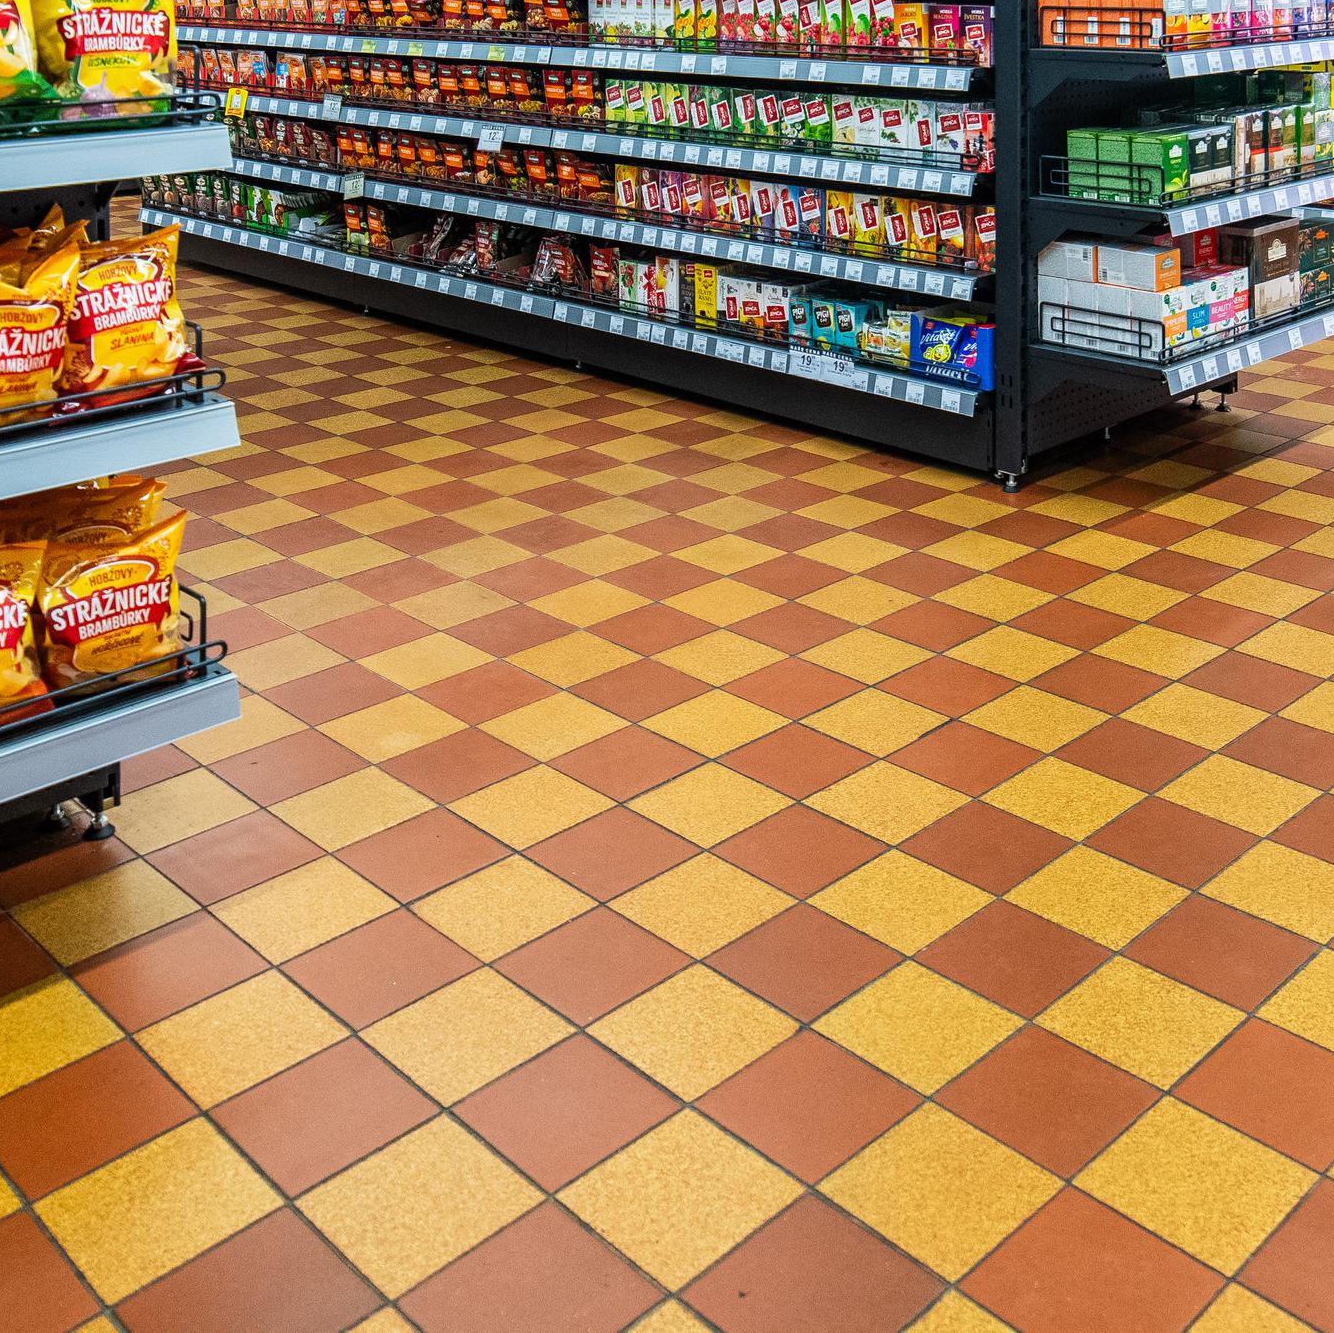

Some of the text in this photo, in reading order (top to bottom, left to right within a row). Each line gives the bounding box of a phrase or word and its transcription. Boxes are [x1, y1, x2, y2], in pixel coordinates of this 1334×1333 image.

[63, 8, 165, 39] STRÁŽNICKÉ
[1211, 304, 1231, 314] BEAUTY
[51, 578, 172, 632] STRÁŽNICKÉ
[78, 607, 150, 640] BRAMBŮRKY
